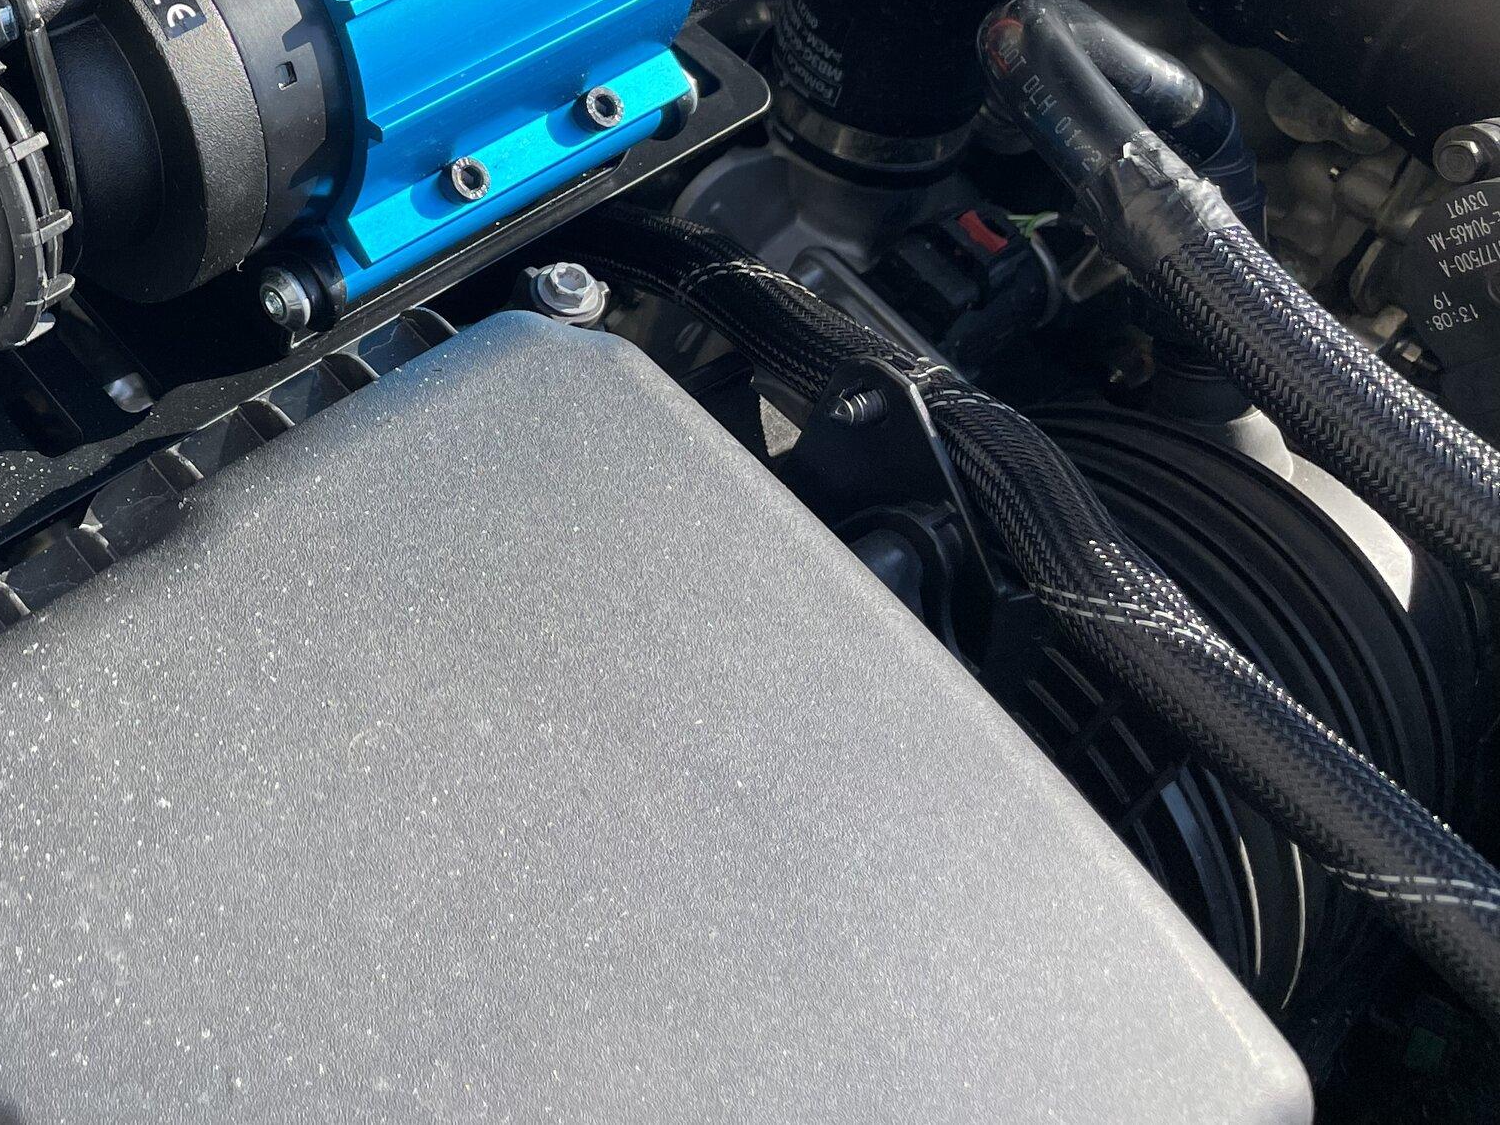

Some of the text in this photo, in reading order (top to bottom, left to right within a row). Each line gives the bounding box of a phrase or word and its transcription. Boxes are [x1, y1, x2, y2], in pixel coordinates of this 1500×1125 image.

[1446, 190, 1489, 219] D3V9T
[1438, 239, 1500, 278] 177500-A
[1433, 291, 1452, 310] 19
